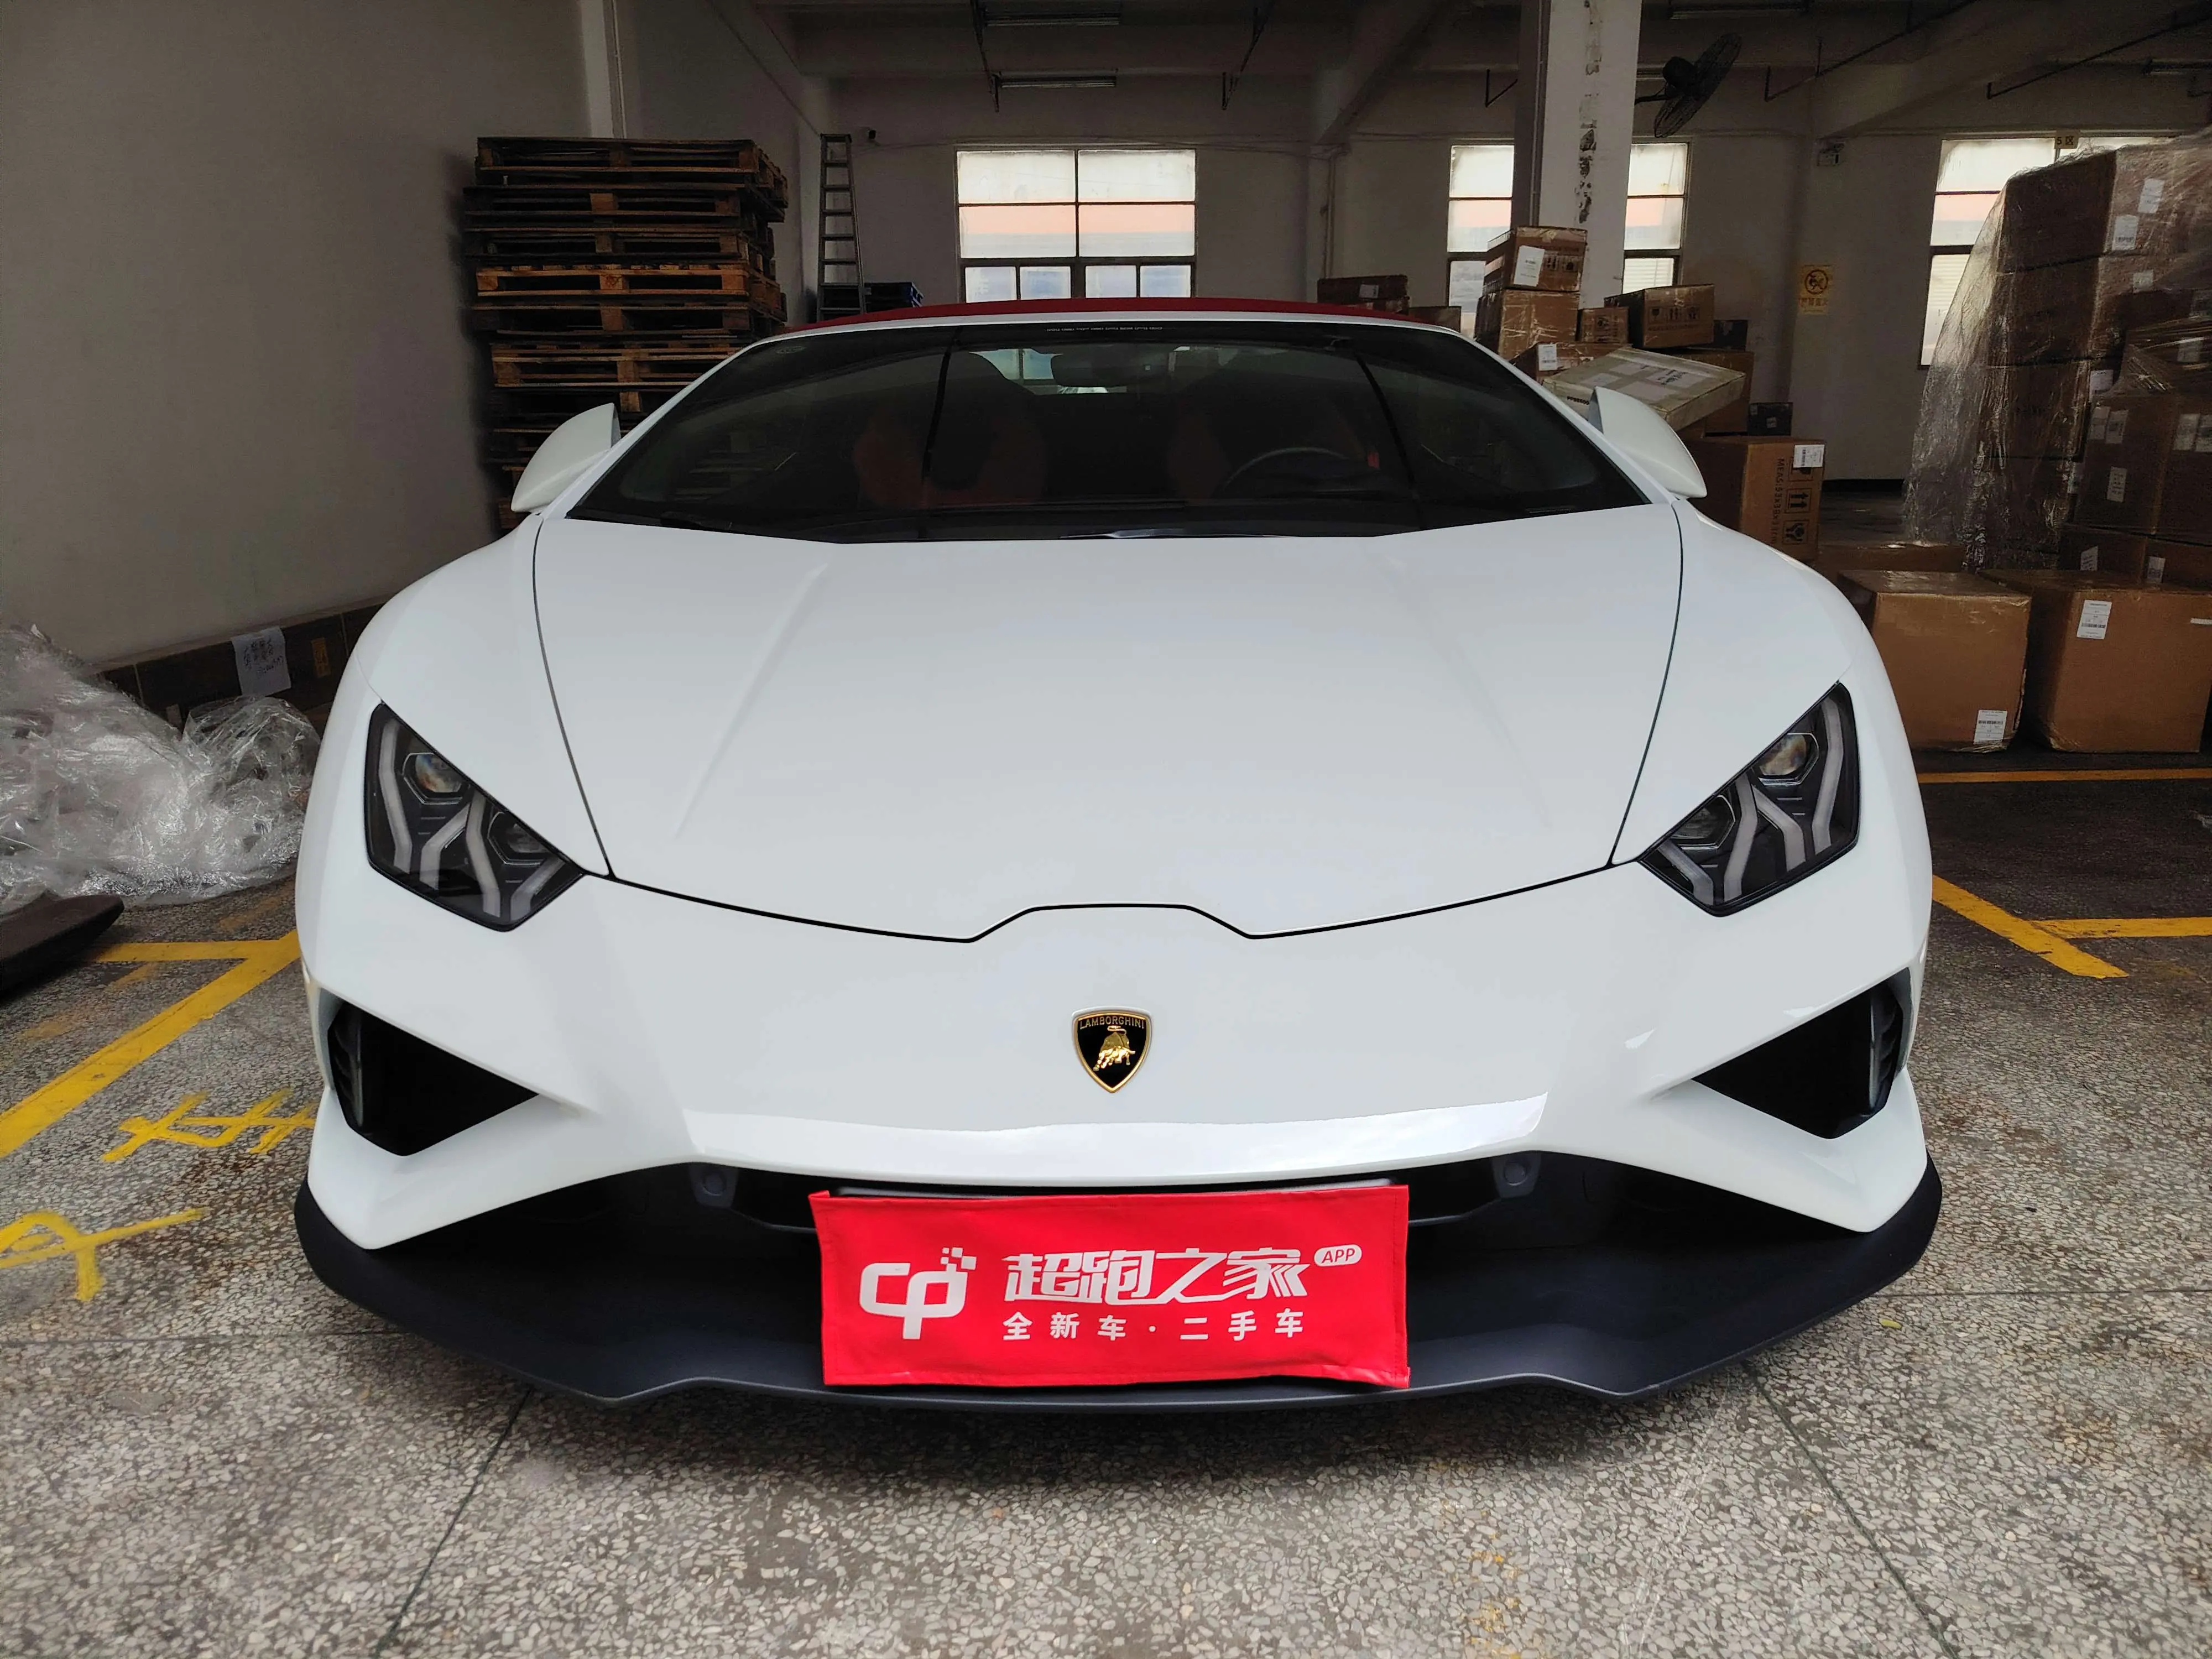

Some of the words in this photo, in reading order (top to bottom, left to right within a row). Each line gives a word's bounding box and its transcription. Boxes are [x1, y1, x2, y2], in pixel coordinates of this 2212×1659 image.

[1079, 1016, 1144, 1030] LAMBORGHINI
[1001, 1248, 1311, 1306] 超跑之家
[1321, 1248, 1355, 1264] APP
